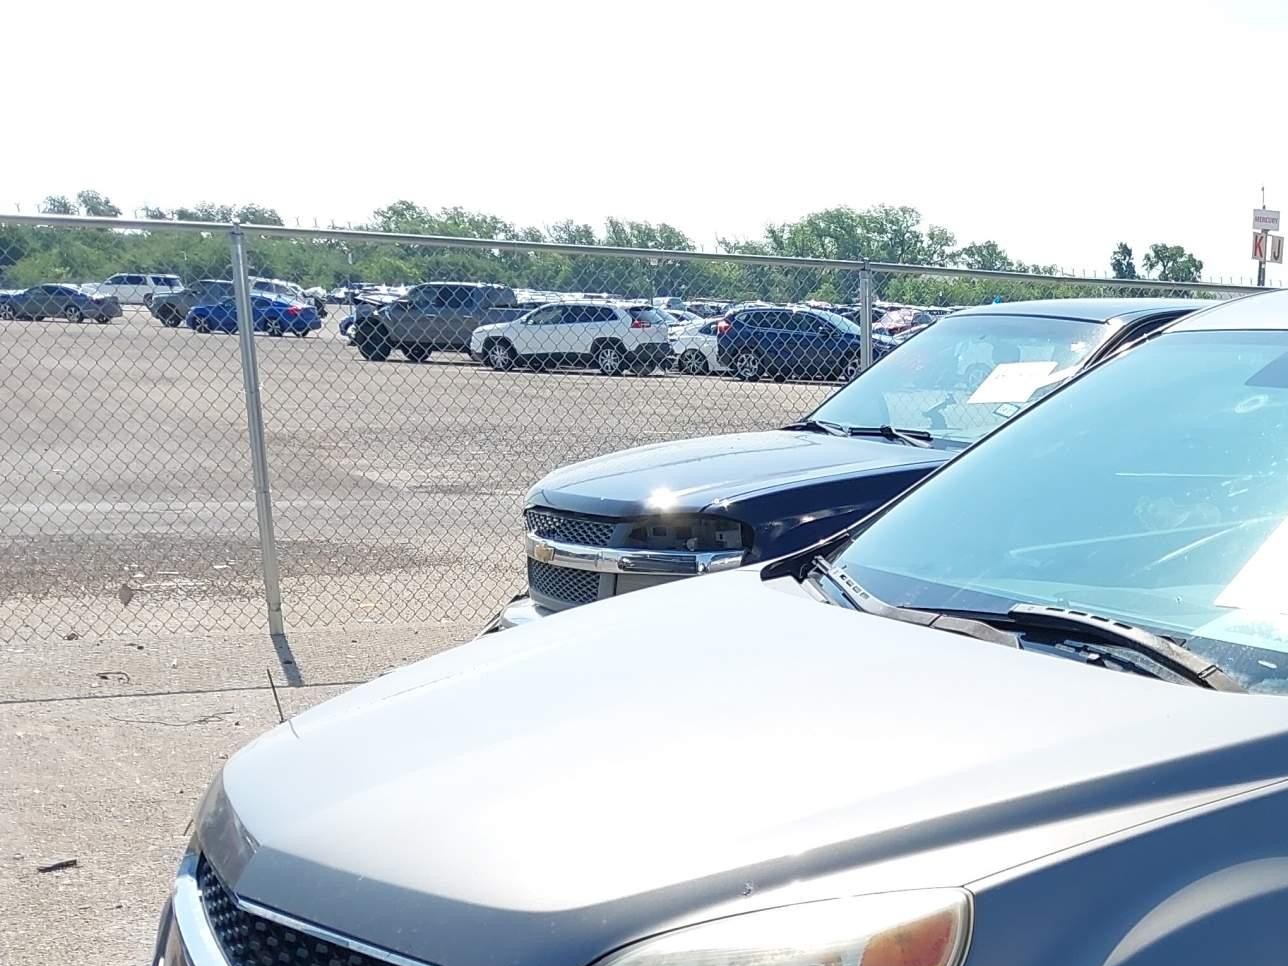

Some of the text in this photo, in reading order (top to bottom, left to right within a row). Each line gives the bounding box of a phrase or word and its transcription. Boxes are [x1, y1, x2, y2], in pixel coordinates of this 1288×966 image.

[1254, 215, 1279, 225] MERCURY
[1254, 235, 1281, 261] K J
